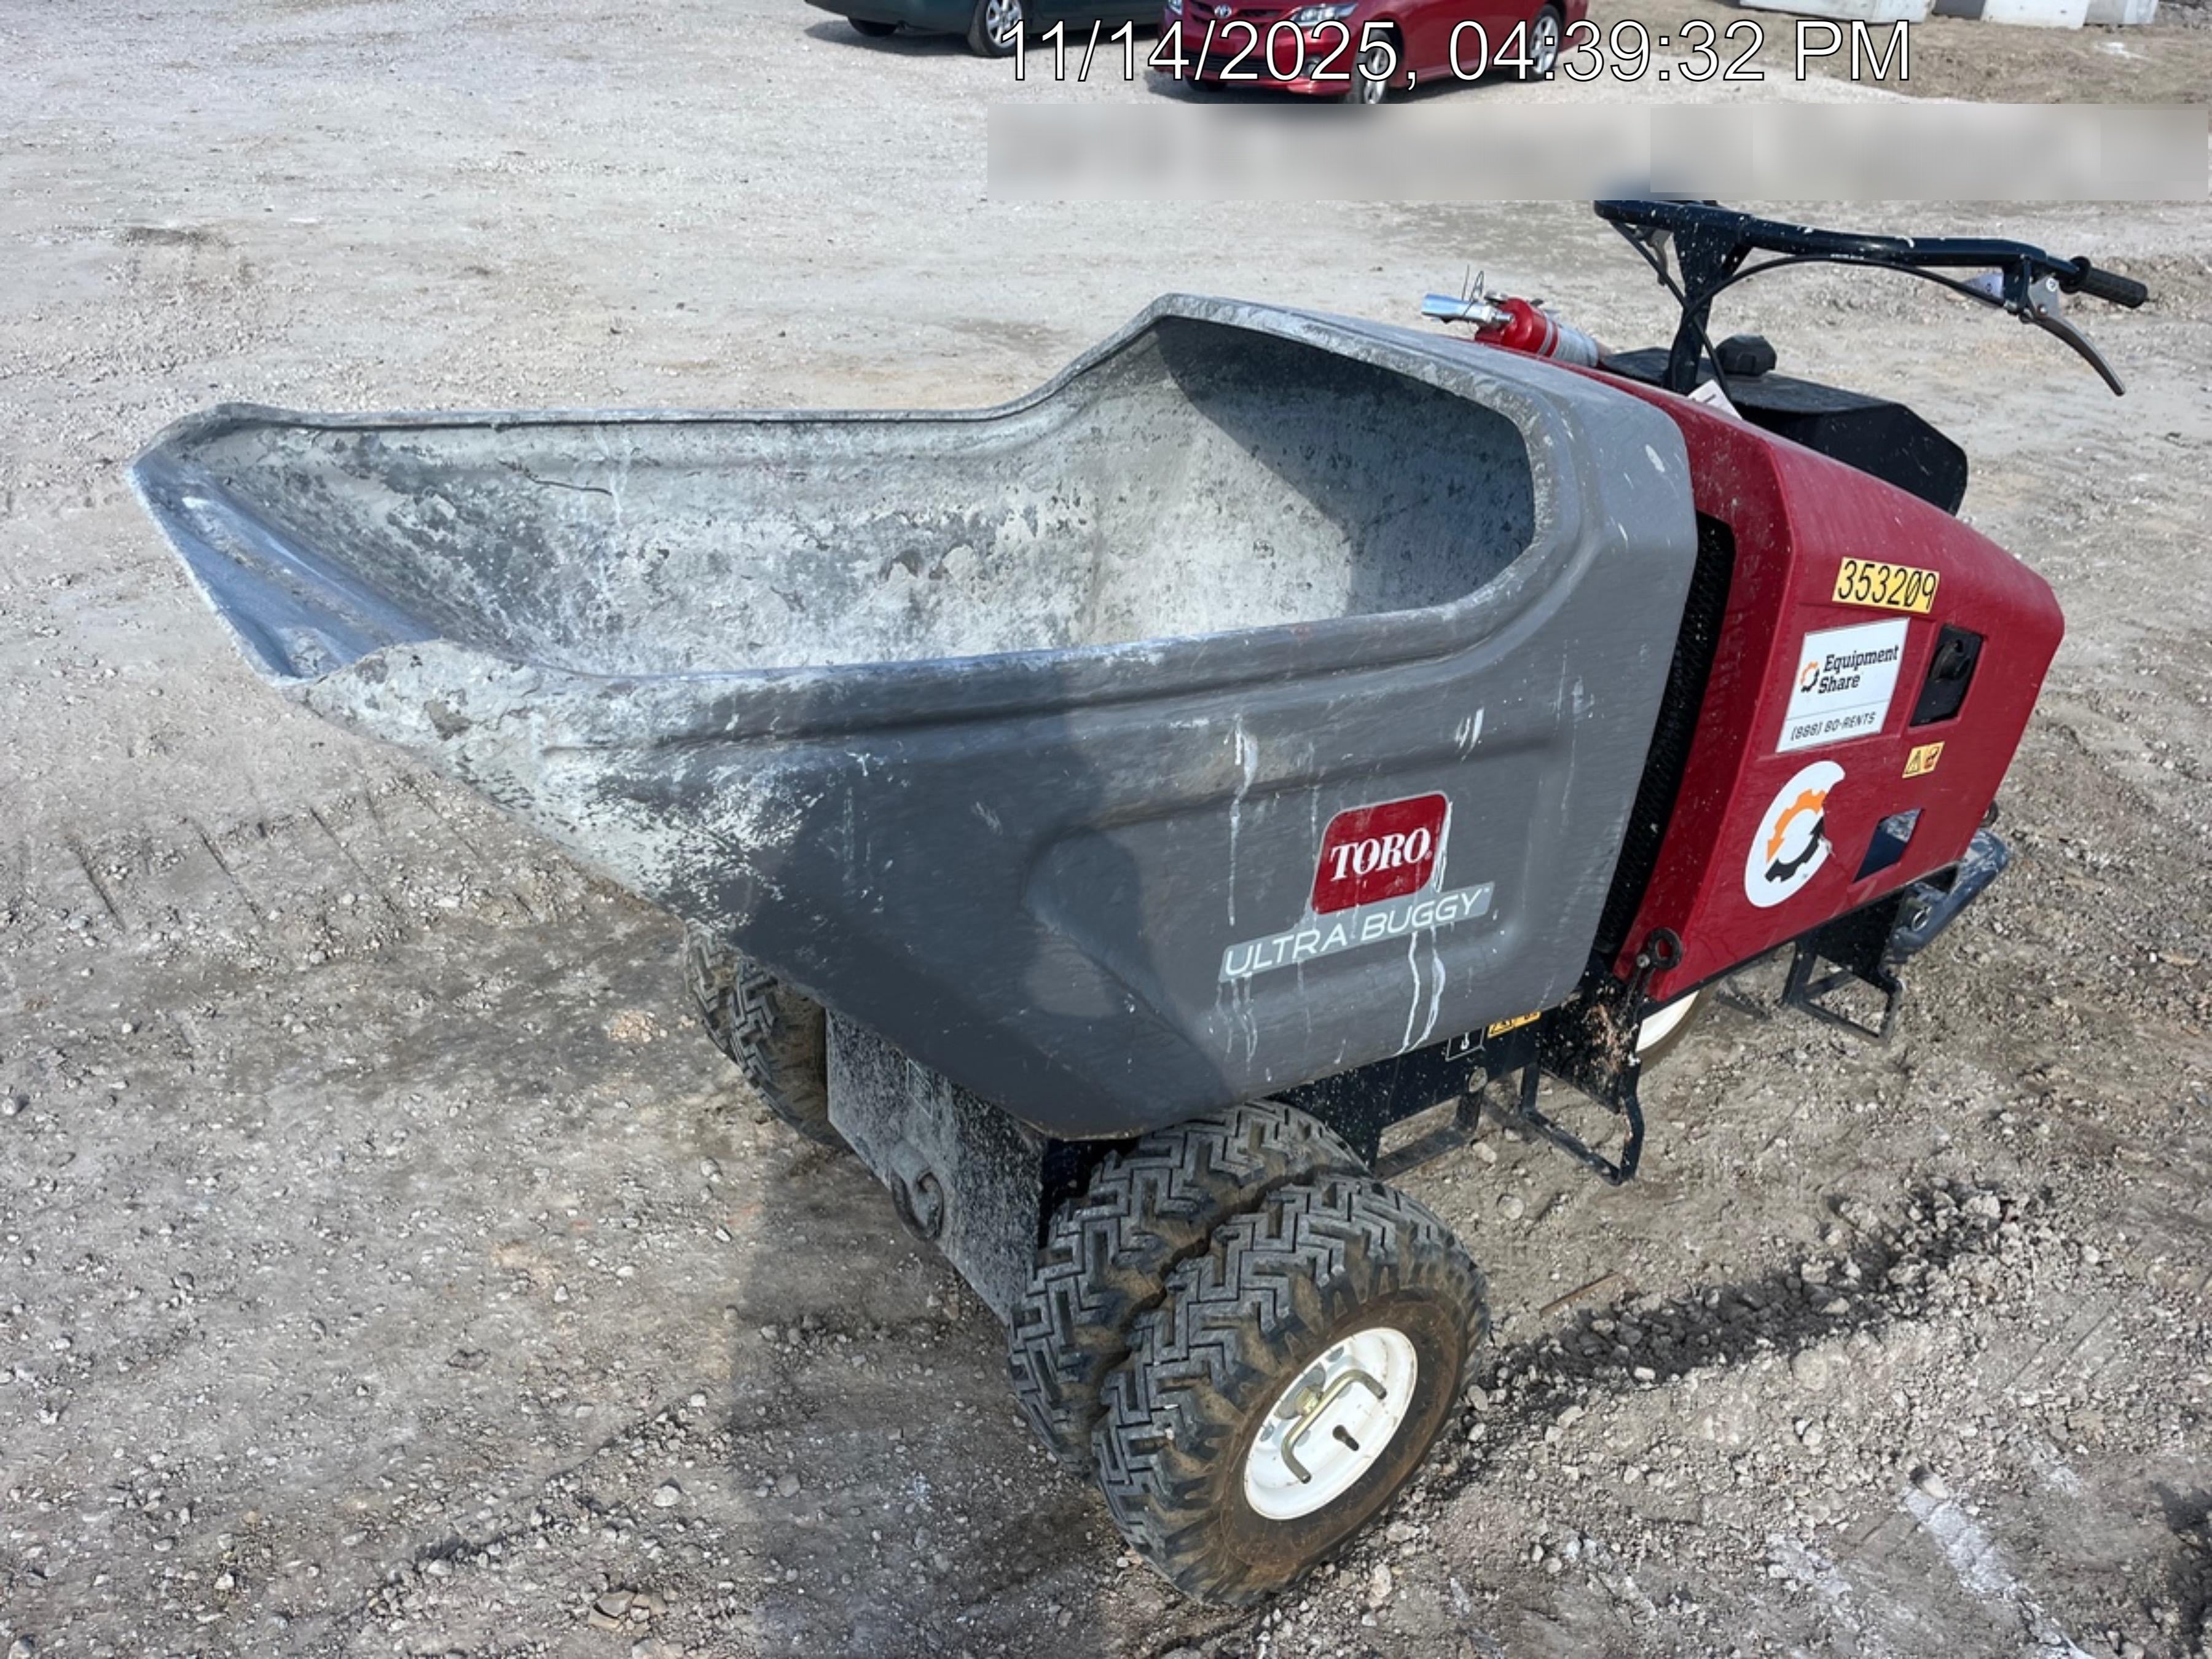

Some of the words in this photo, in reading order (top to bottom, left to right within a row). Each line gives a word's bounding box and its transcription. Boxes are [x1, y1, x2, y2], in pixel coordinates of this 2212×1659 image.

[1838, 560, 1937, 610] 353209
[1818, 673, 1861, 694] Share
[1823, 645, 1899, 675] Equipment
[1329, 827, 1431, 880] TORO
[1225, 924, 1347, 975] ULTRA
[1361, 889, 1482, 942] BUGGY
